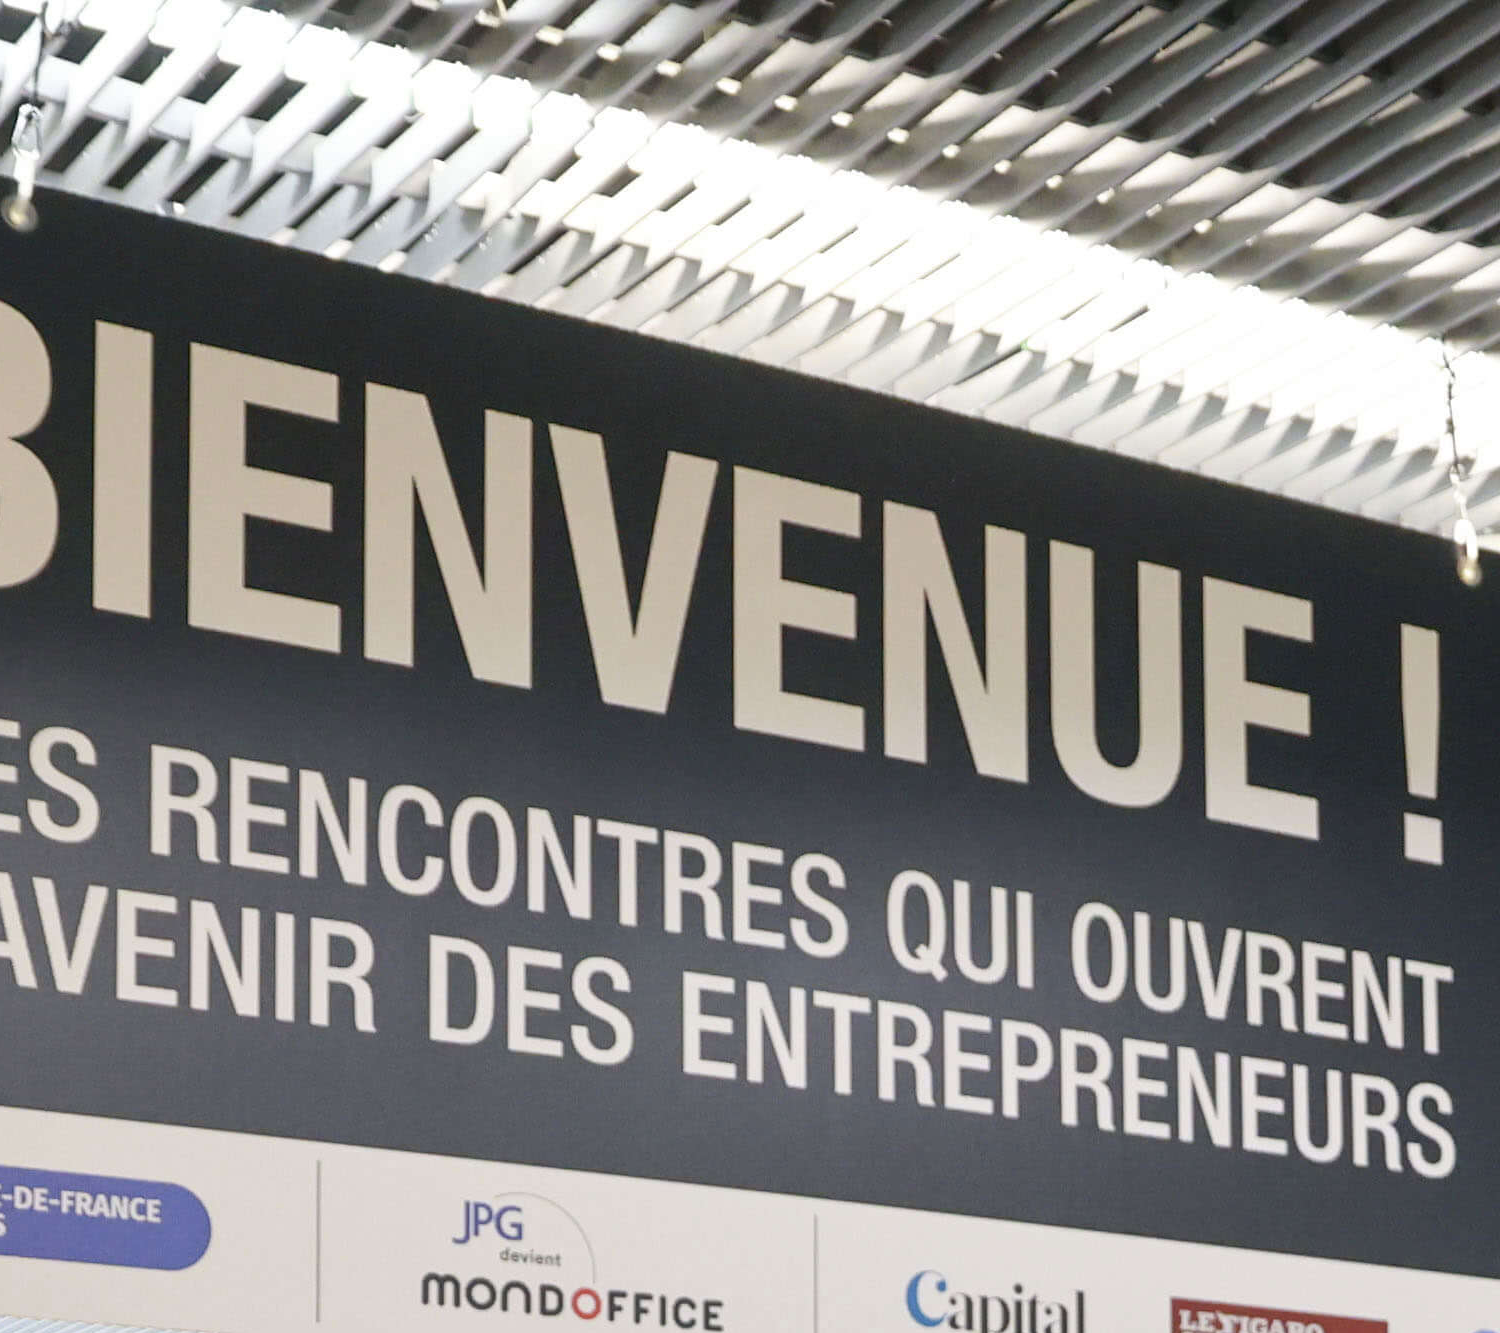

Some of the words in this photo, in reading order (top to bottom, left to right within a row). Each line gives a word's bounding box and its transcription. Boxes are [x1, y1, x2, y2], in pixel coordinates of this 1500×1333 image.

[1402, 624, 1442, 864] !
[151, 745, 848, 958] RENCONTRES
[888, 871, 1033, 989] QUI
[1072, 903, 1453, 1054] OUVRENT
[430, 935, 633, 1065] DES
[683, 971, 1455, 1178] ENTREPRENEURS
[452, 1200, 524, 1244] JPG
[500, 1248, 561, 1267] devient
